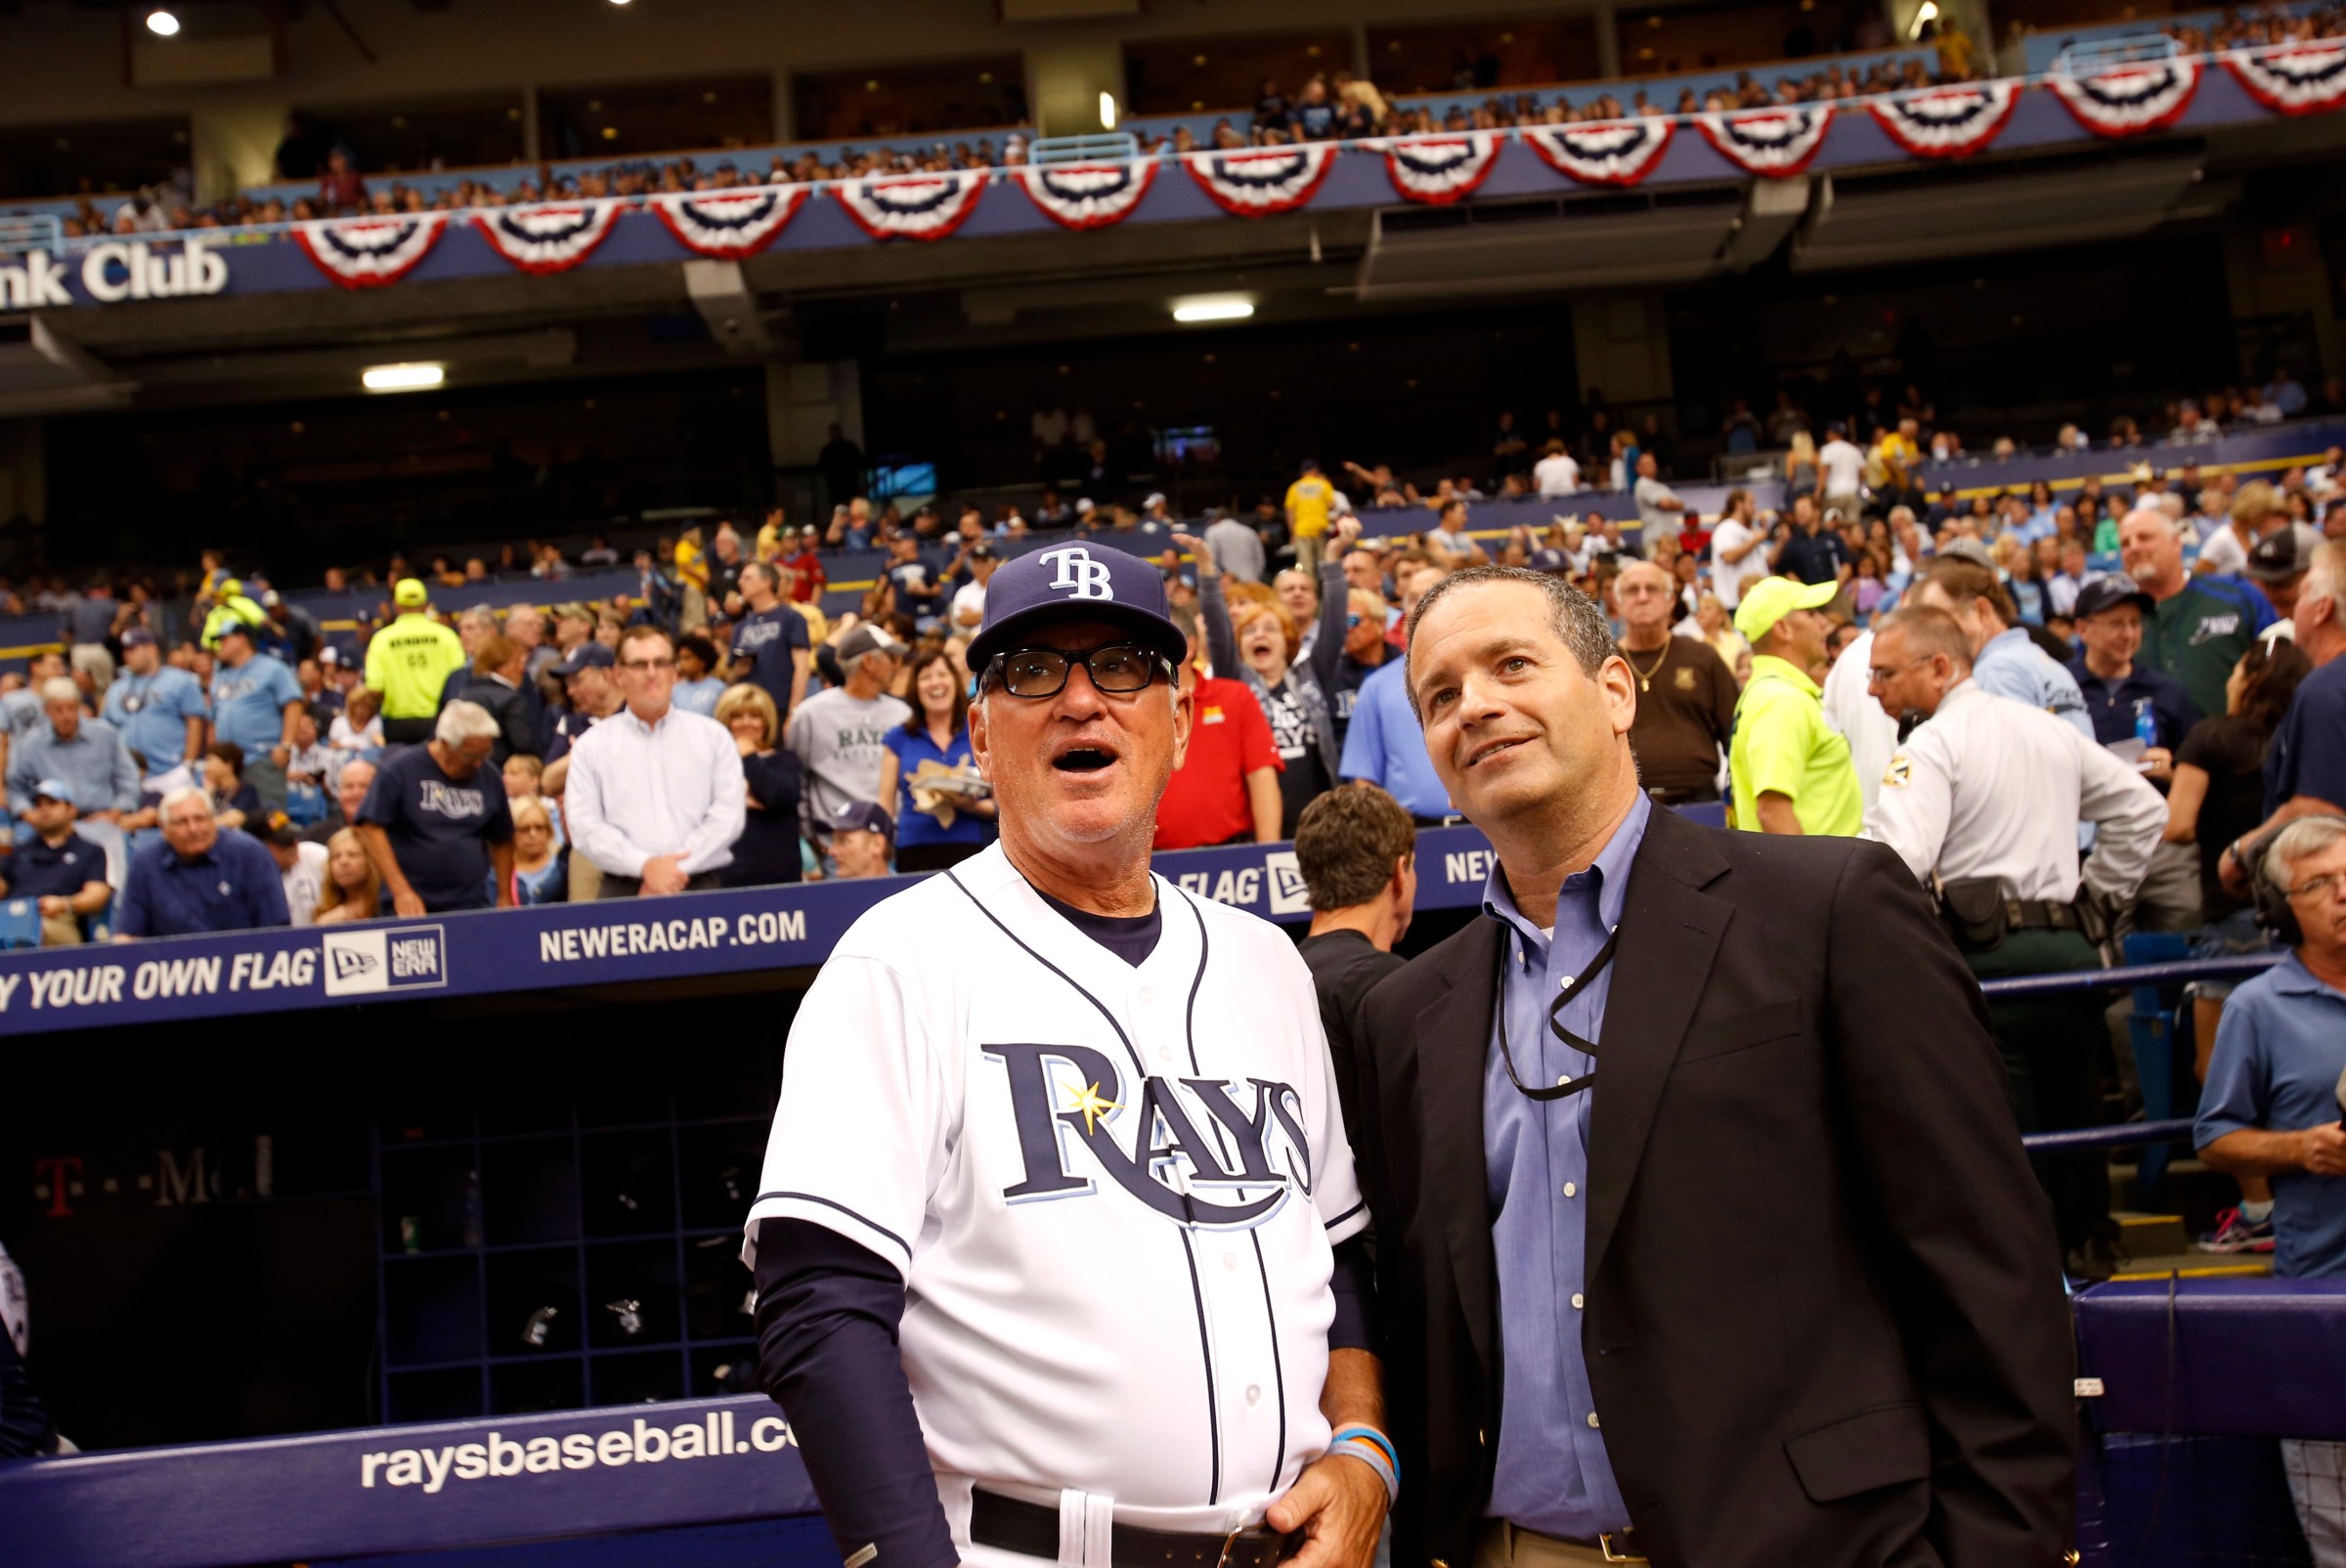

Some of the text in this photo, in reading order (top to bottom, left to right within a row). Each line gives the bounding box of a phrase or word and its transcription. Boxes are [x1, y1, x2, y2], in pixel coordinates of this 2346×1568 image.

[82, 238, 228, 302] Club
[391, 938, 437, 960] NEW
[540, 910, 806, 963] NEWERACAP.COM
[28, 964, 125, 1010] YOUR
[133, 955, 222, 1000] OWN
[392, 955, 438, 978] ERA
[980, 1043, 1314, 1232] RAYS
